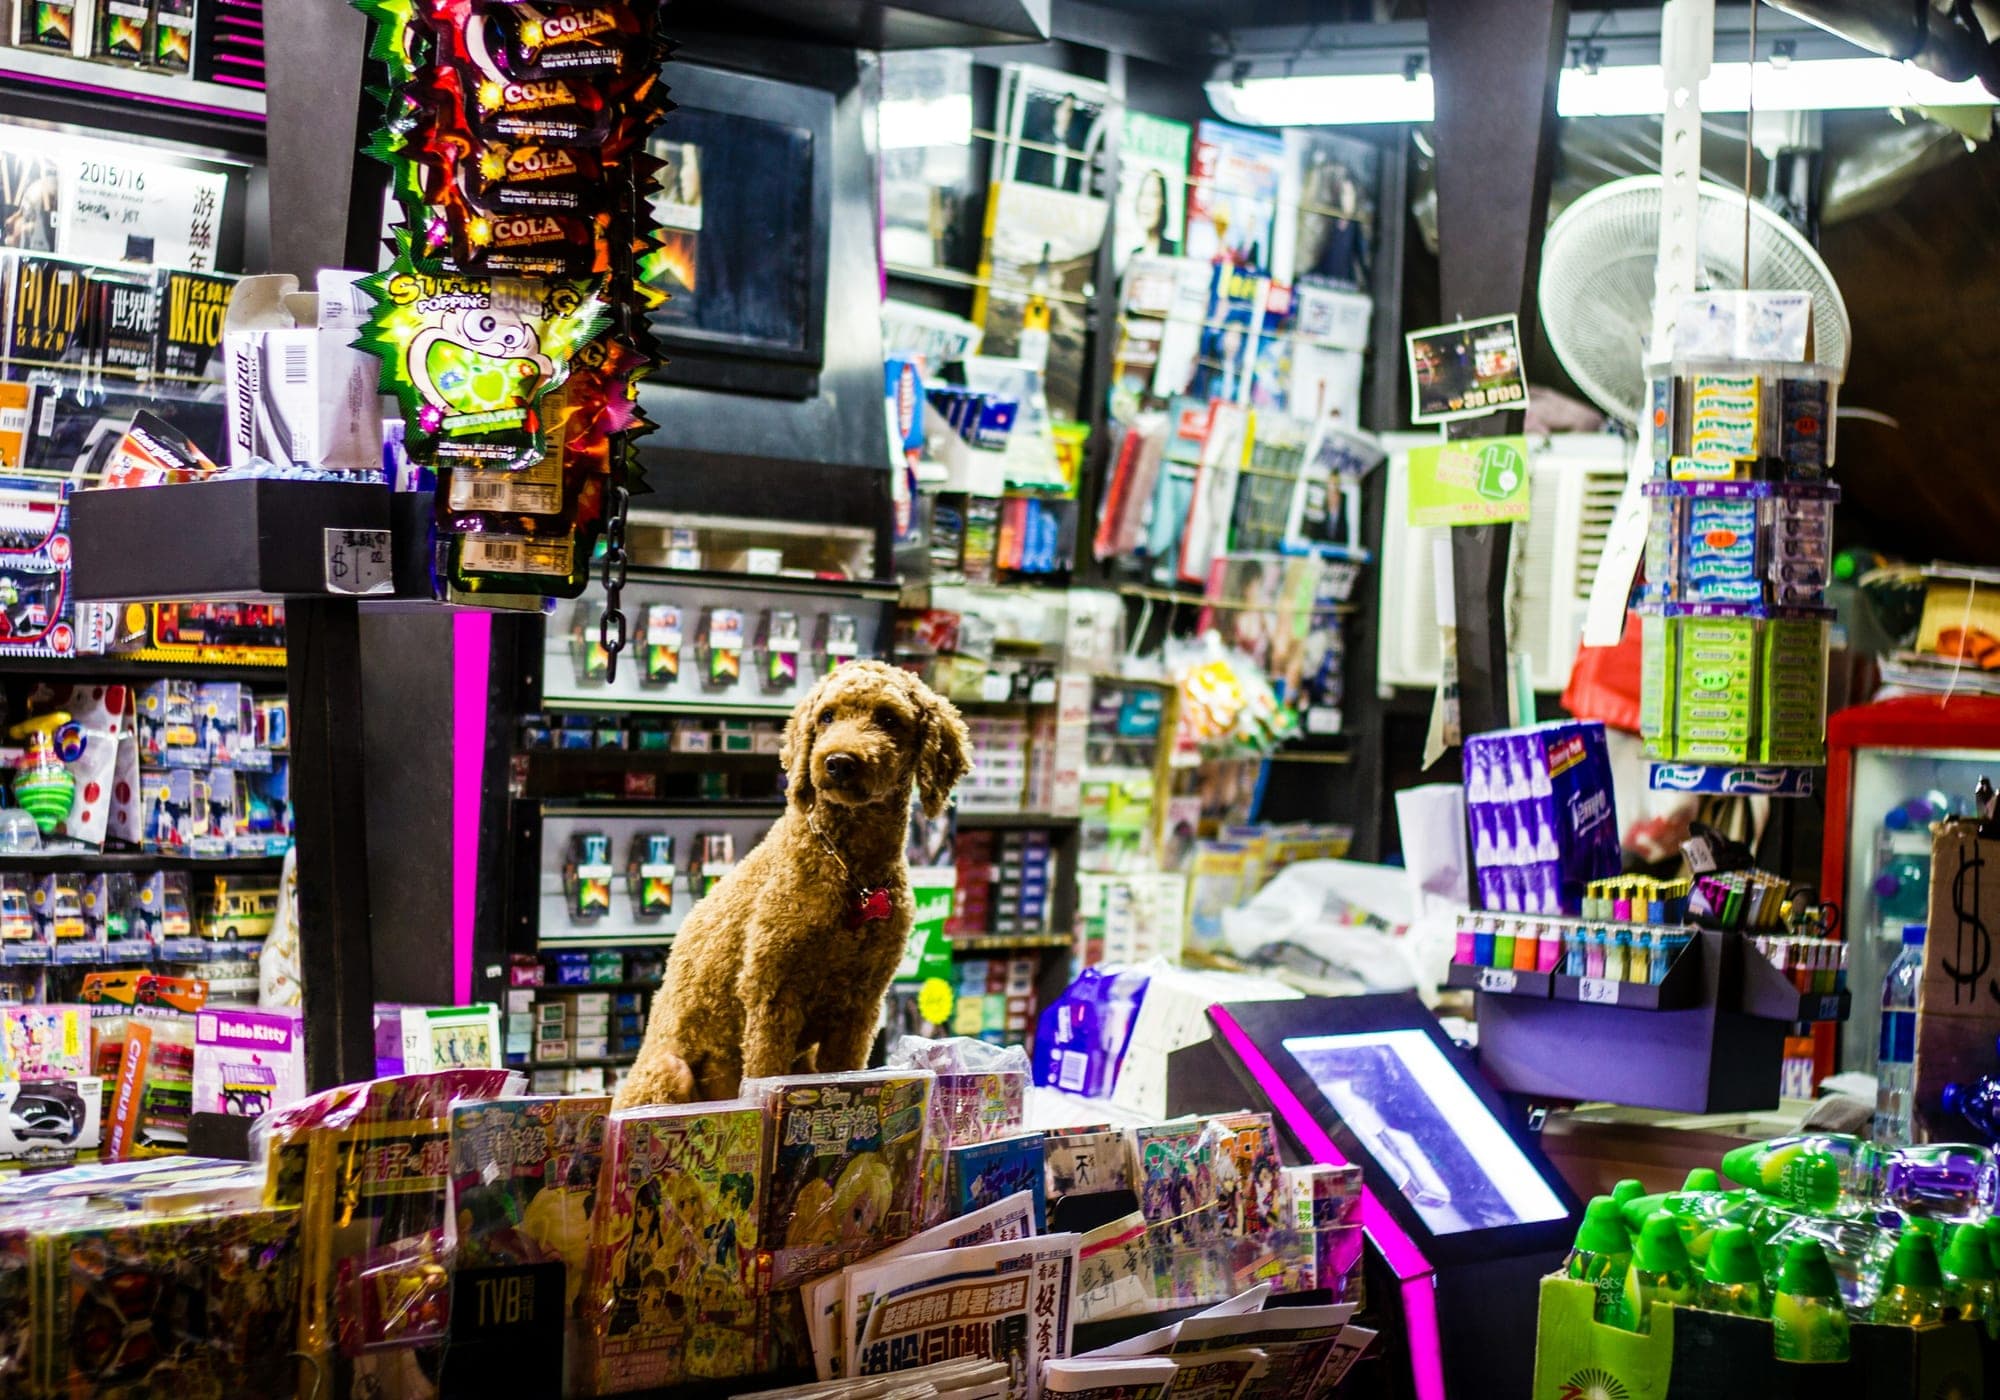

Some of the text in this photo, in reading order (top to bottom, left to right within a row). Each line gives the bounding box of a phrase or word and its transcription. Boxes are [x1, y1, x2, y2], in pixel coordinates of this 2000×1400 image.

[543, 8, 615, 37] COLA
[504, 80, 573, 103] COLA
[506, 148, 574, 173] COLA
[79, 161, 145, 191] 2015/16
[495, 217, 561, 239] COLA
[417, 294, 490, 314] POPPING
[237, 349, 254, 453] Energizer
[219, 1021, 288, 1045] Hello Kitty
[116, 1038, 142, 1122] CITYBUS
[476, 1276, 521, 1328] TVB
